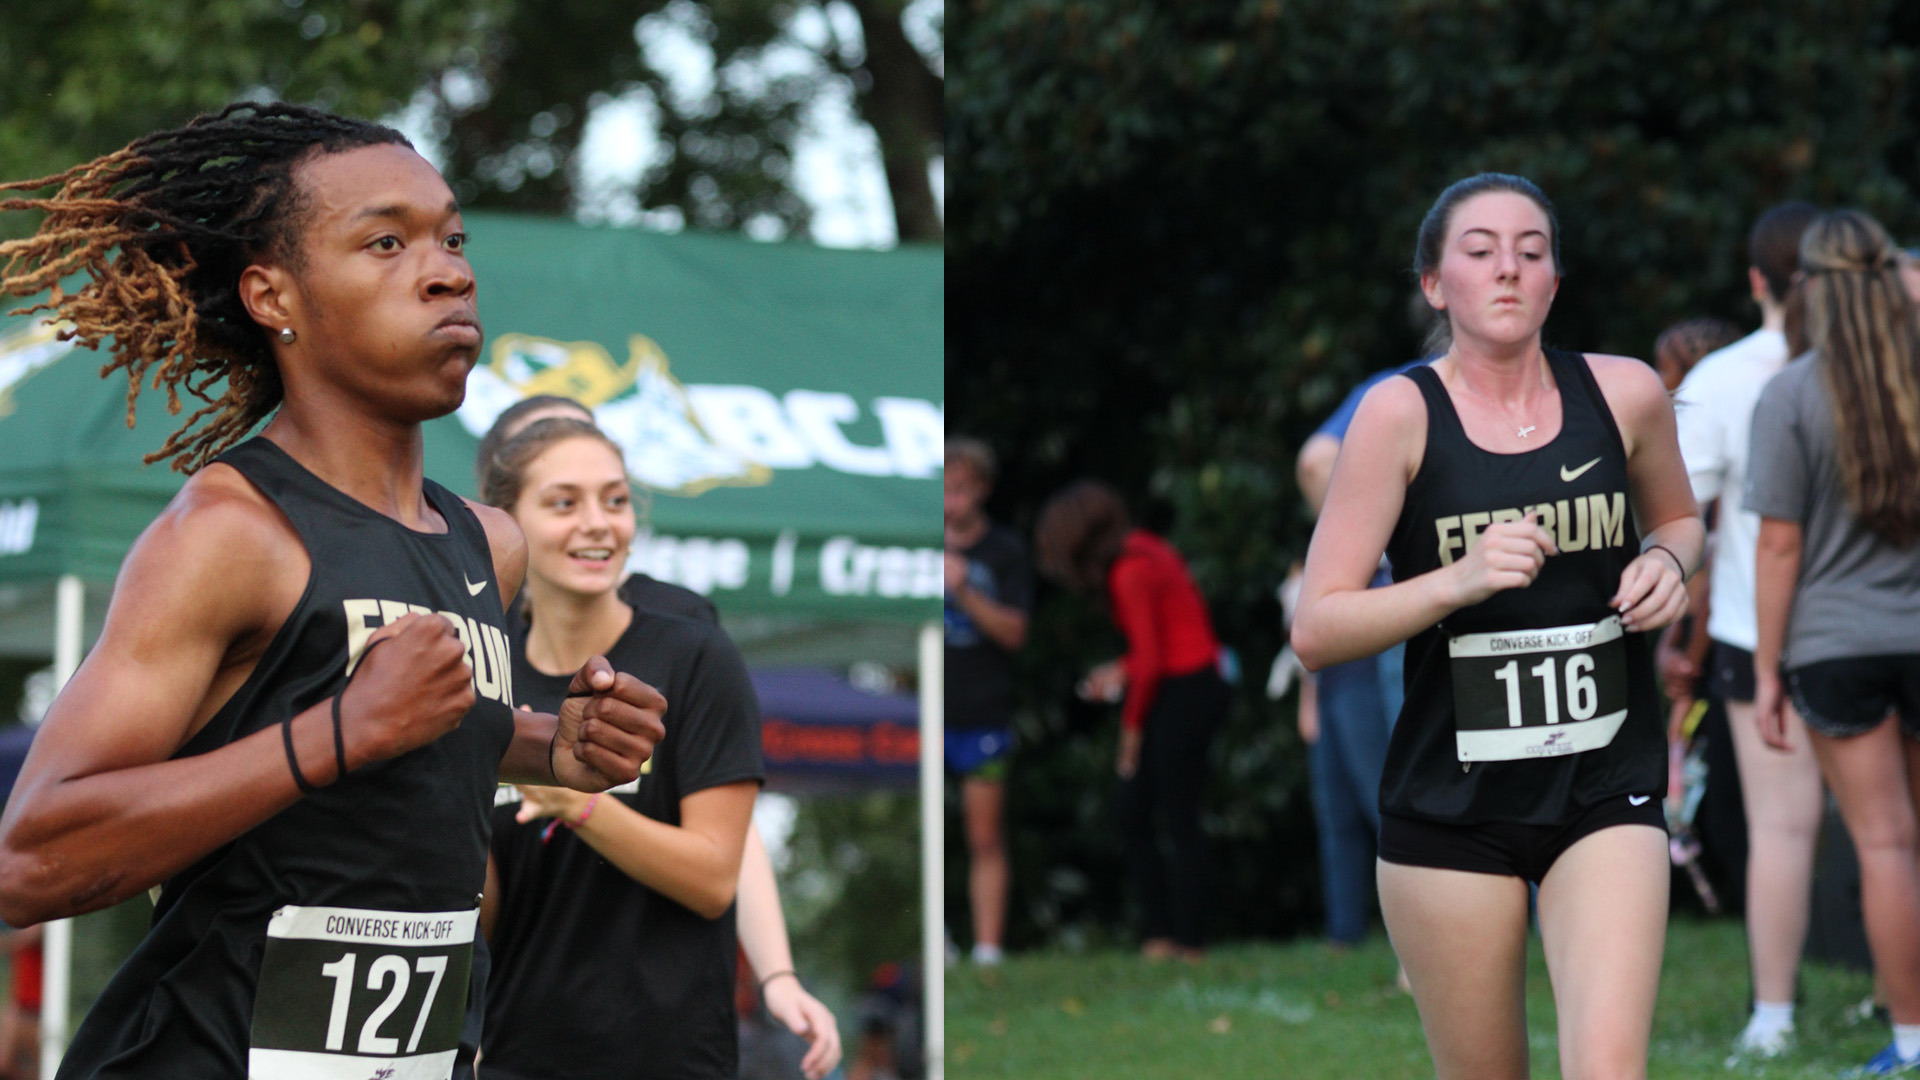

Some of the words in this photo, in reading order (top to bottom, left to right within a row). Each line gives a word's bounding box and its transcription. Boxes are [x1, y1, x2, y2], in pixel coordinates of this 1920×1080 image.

[343, 599, 513, 709] FRUM
[1490, 636, 1544, 652] CONVERSE
[1546, 630, 1593, 647] KICK-OFF
[1494, 653, 1598, 728] 116
[326, 915, 399, 939] CONVERSE
[402, 919, 454, 940] KICK-OFF
[321, 952, 449, 1054] 127
